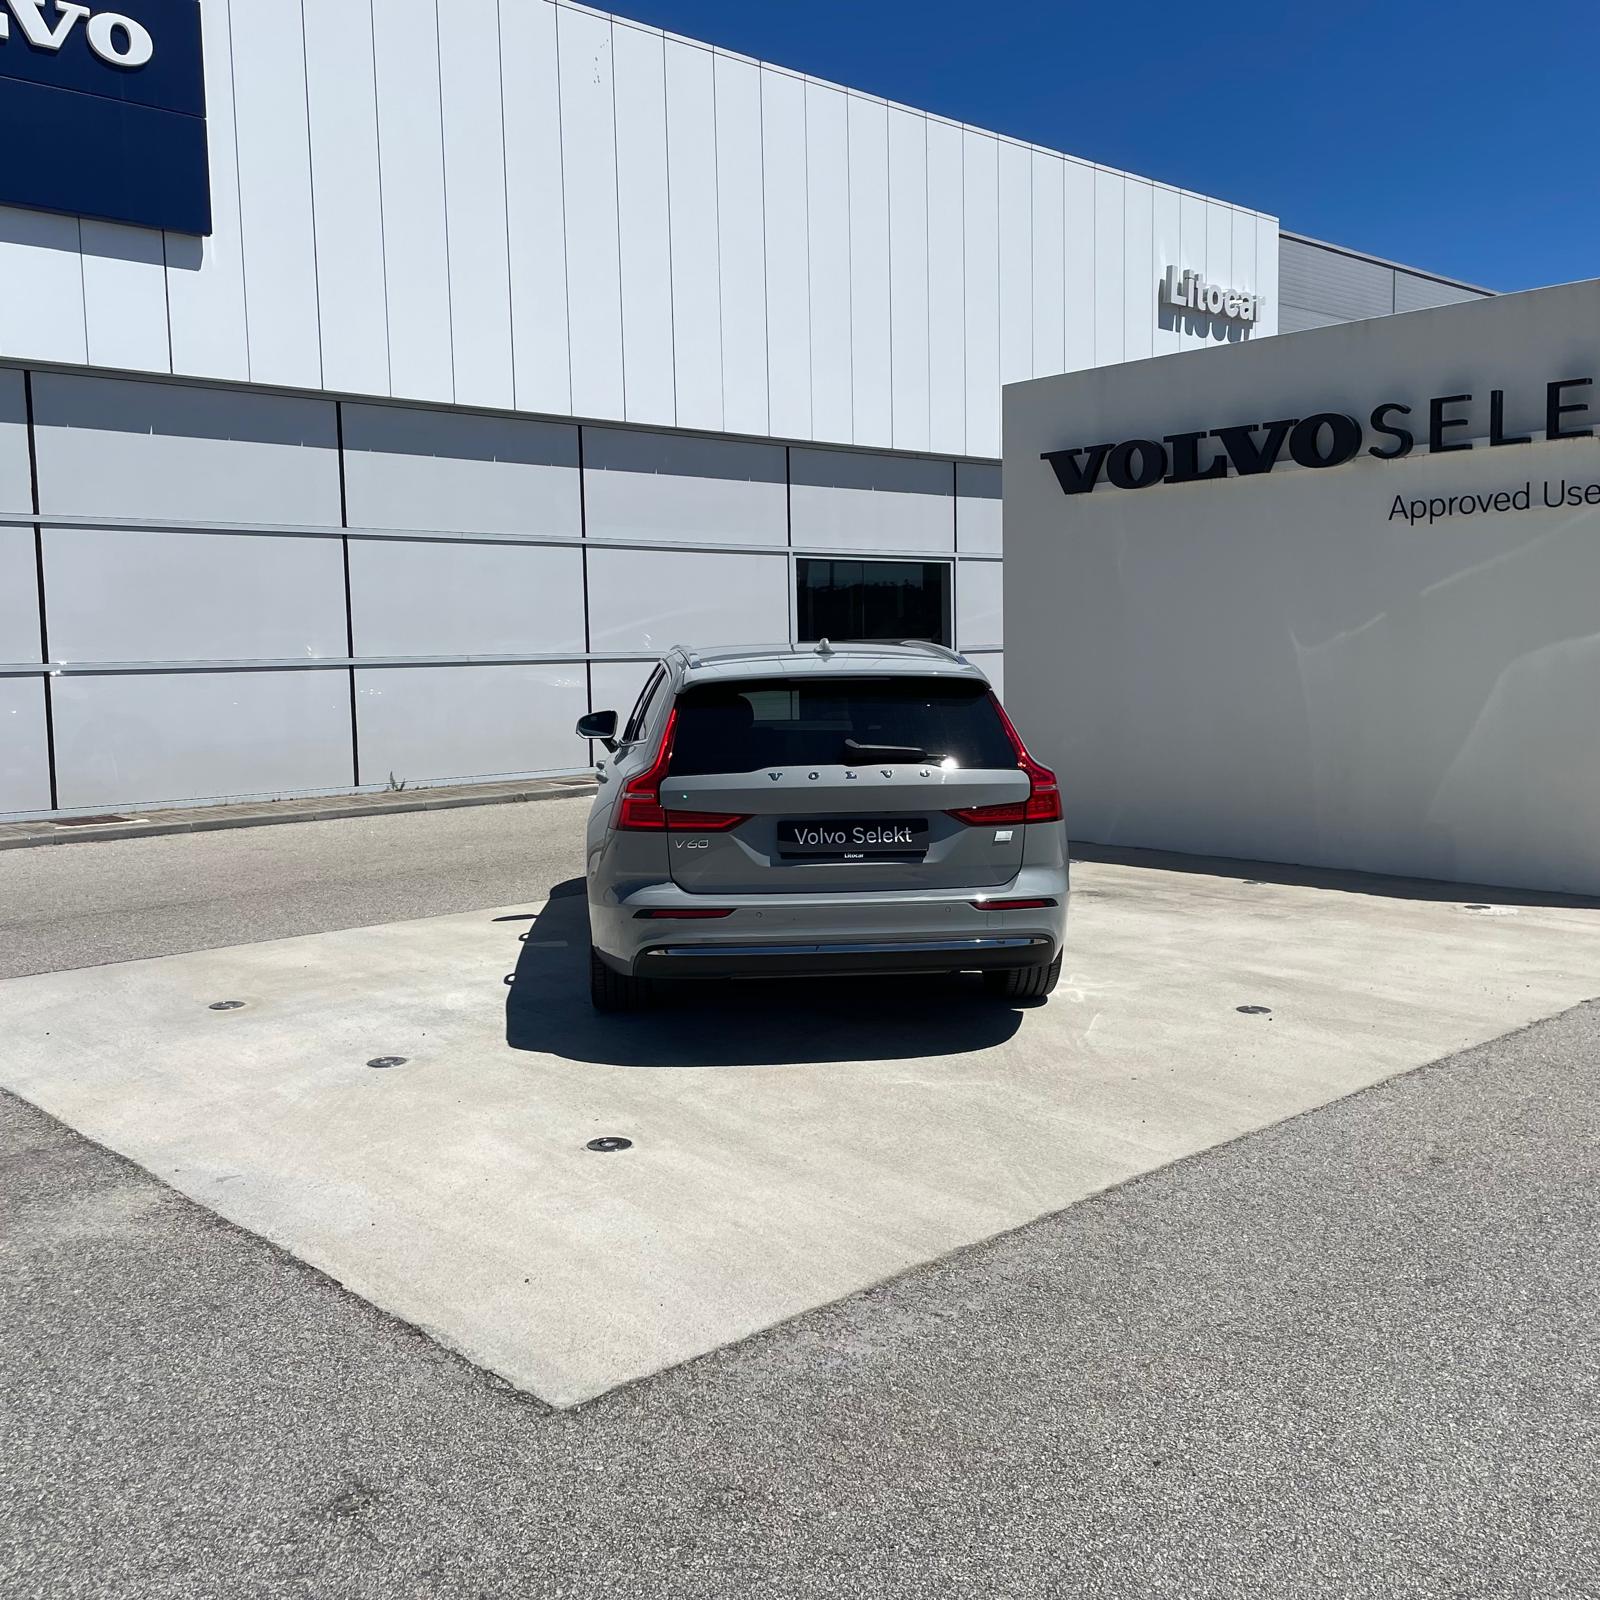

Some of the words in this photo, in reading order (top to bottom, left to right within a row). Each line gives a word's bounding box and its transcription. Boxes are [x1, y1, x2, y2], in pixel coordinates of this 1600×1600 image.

[0, 0, 153, 66] VO
[1388, 482, 1530, 526] Approved
[768, 770, 931, 782] VOLVO
[675, 839, 709, 849] V60
[794, 828, 846, 846] Volvo
[852, 826, 913, 844] Selekt
